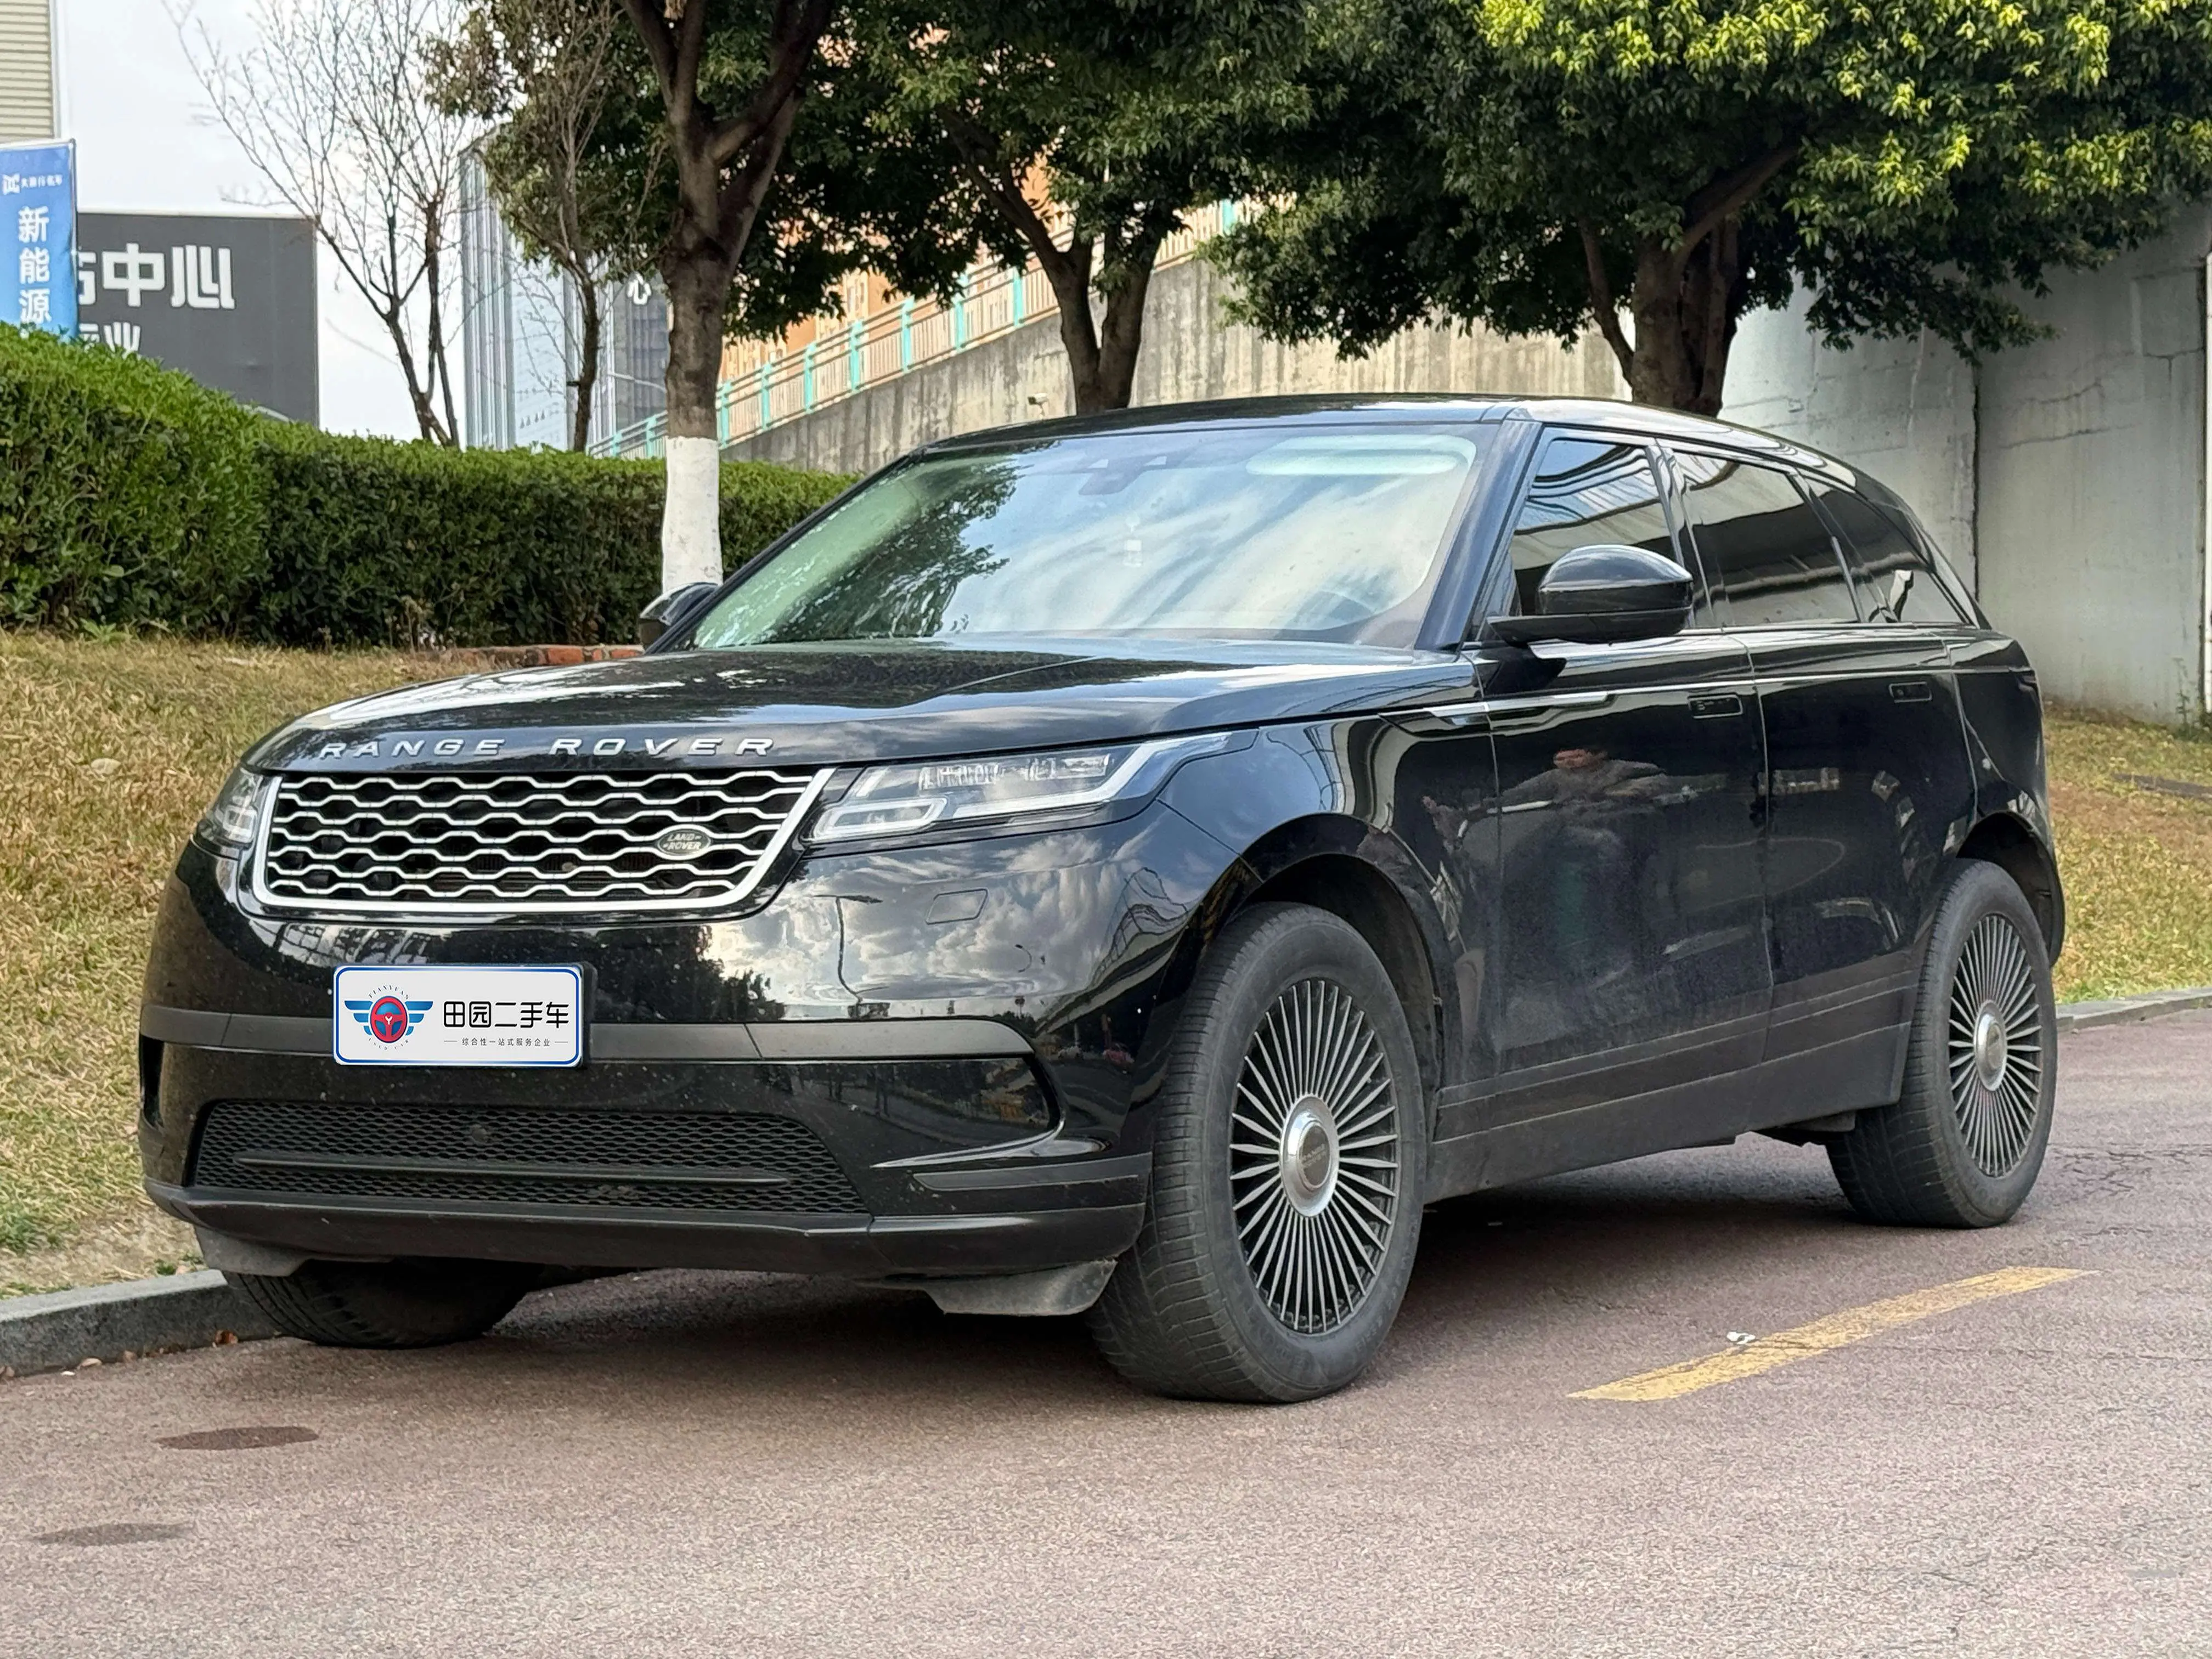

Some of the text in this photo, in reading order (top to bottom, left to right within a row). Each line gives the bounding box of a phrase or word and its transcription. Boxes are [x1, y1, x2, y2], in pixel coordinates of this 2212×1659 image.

[18, 206, 52, 338] 新能源
[319, 738, 774, 759] RANGE ROVER
[667, 833, 695, 842] LAND
[667, 842, 702, 850] ROVER
